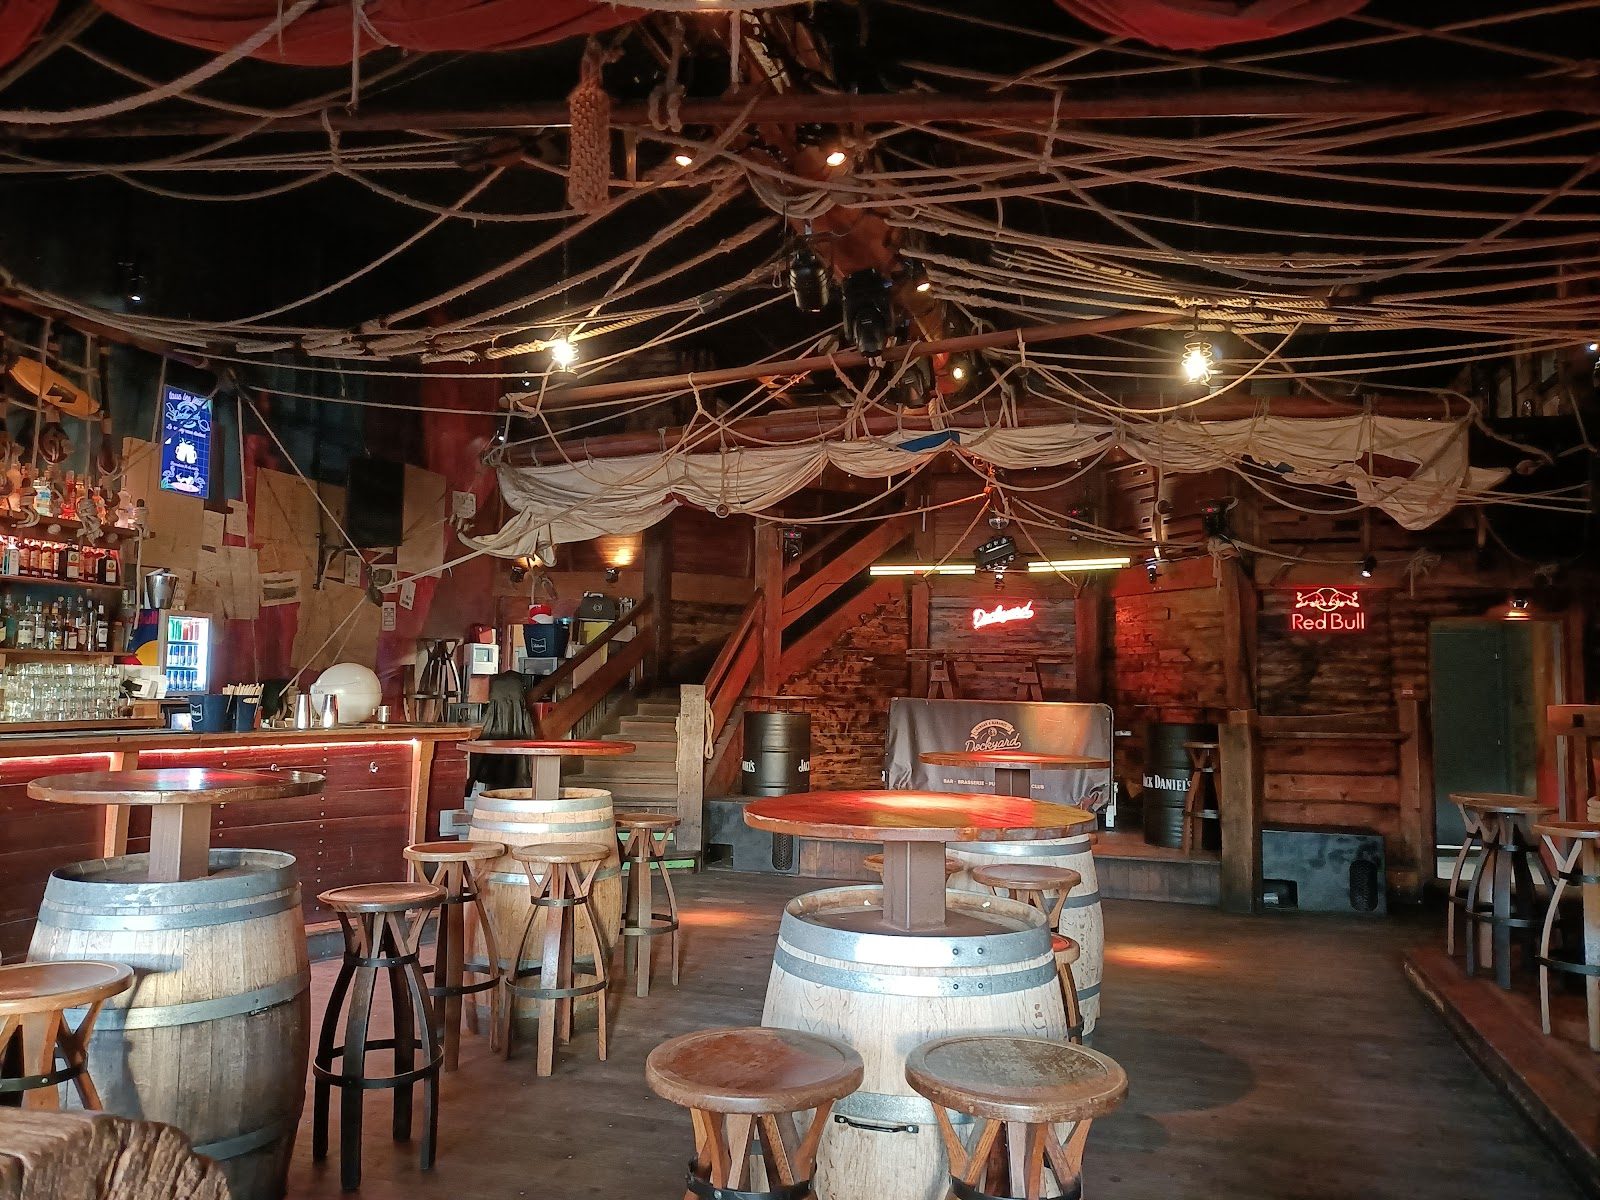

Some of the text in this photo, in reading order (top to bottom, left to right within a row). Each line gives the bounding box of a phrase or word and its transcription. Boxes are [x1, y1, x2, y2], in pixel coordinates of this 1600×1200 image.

[1292, 612, 1365, 630] Red Bull
[965, 733, 1022, 752] Dockyard
[1154, 774, 1192, 791] DANIEL'S
